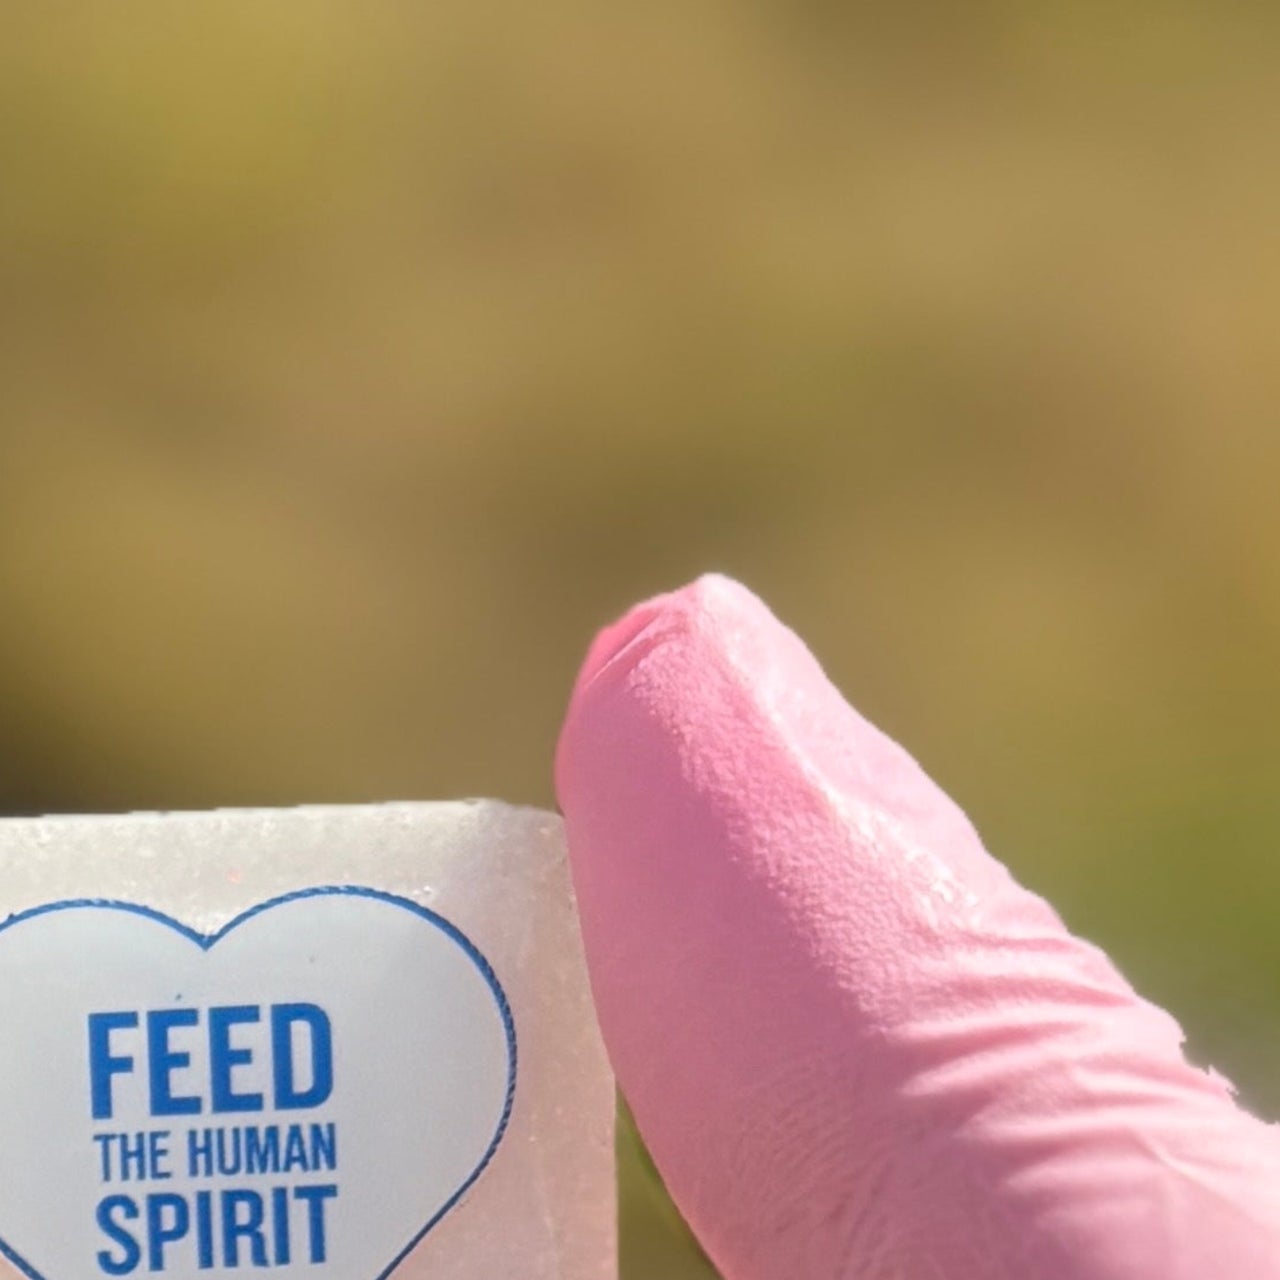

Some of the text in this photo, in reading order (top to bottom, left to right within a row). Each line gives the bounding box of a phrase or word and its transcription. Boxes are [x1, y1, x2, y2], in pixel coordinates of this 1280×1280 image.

[87, 1002, 334, 1121] FEED
[93, 1123, 337, 1182] THE HUMAN
[95, 1185, 338, 1276] SPIRIT
